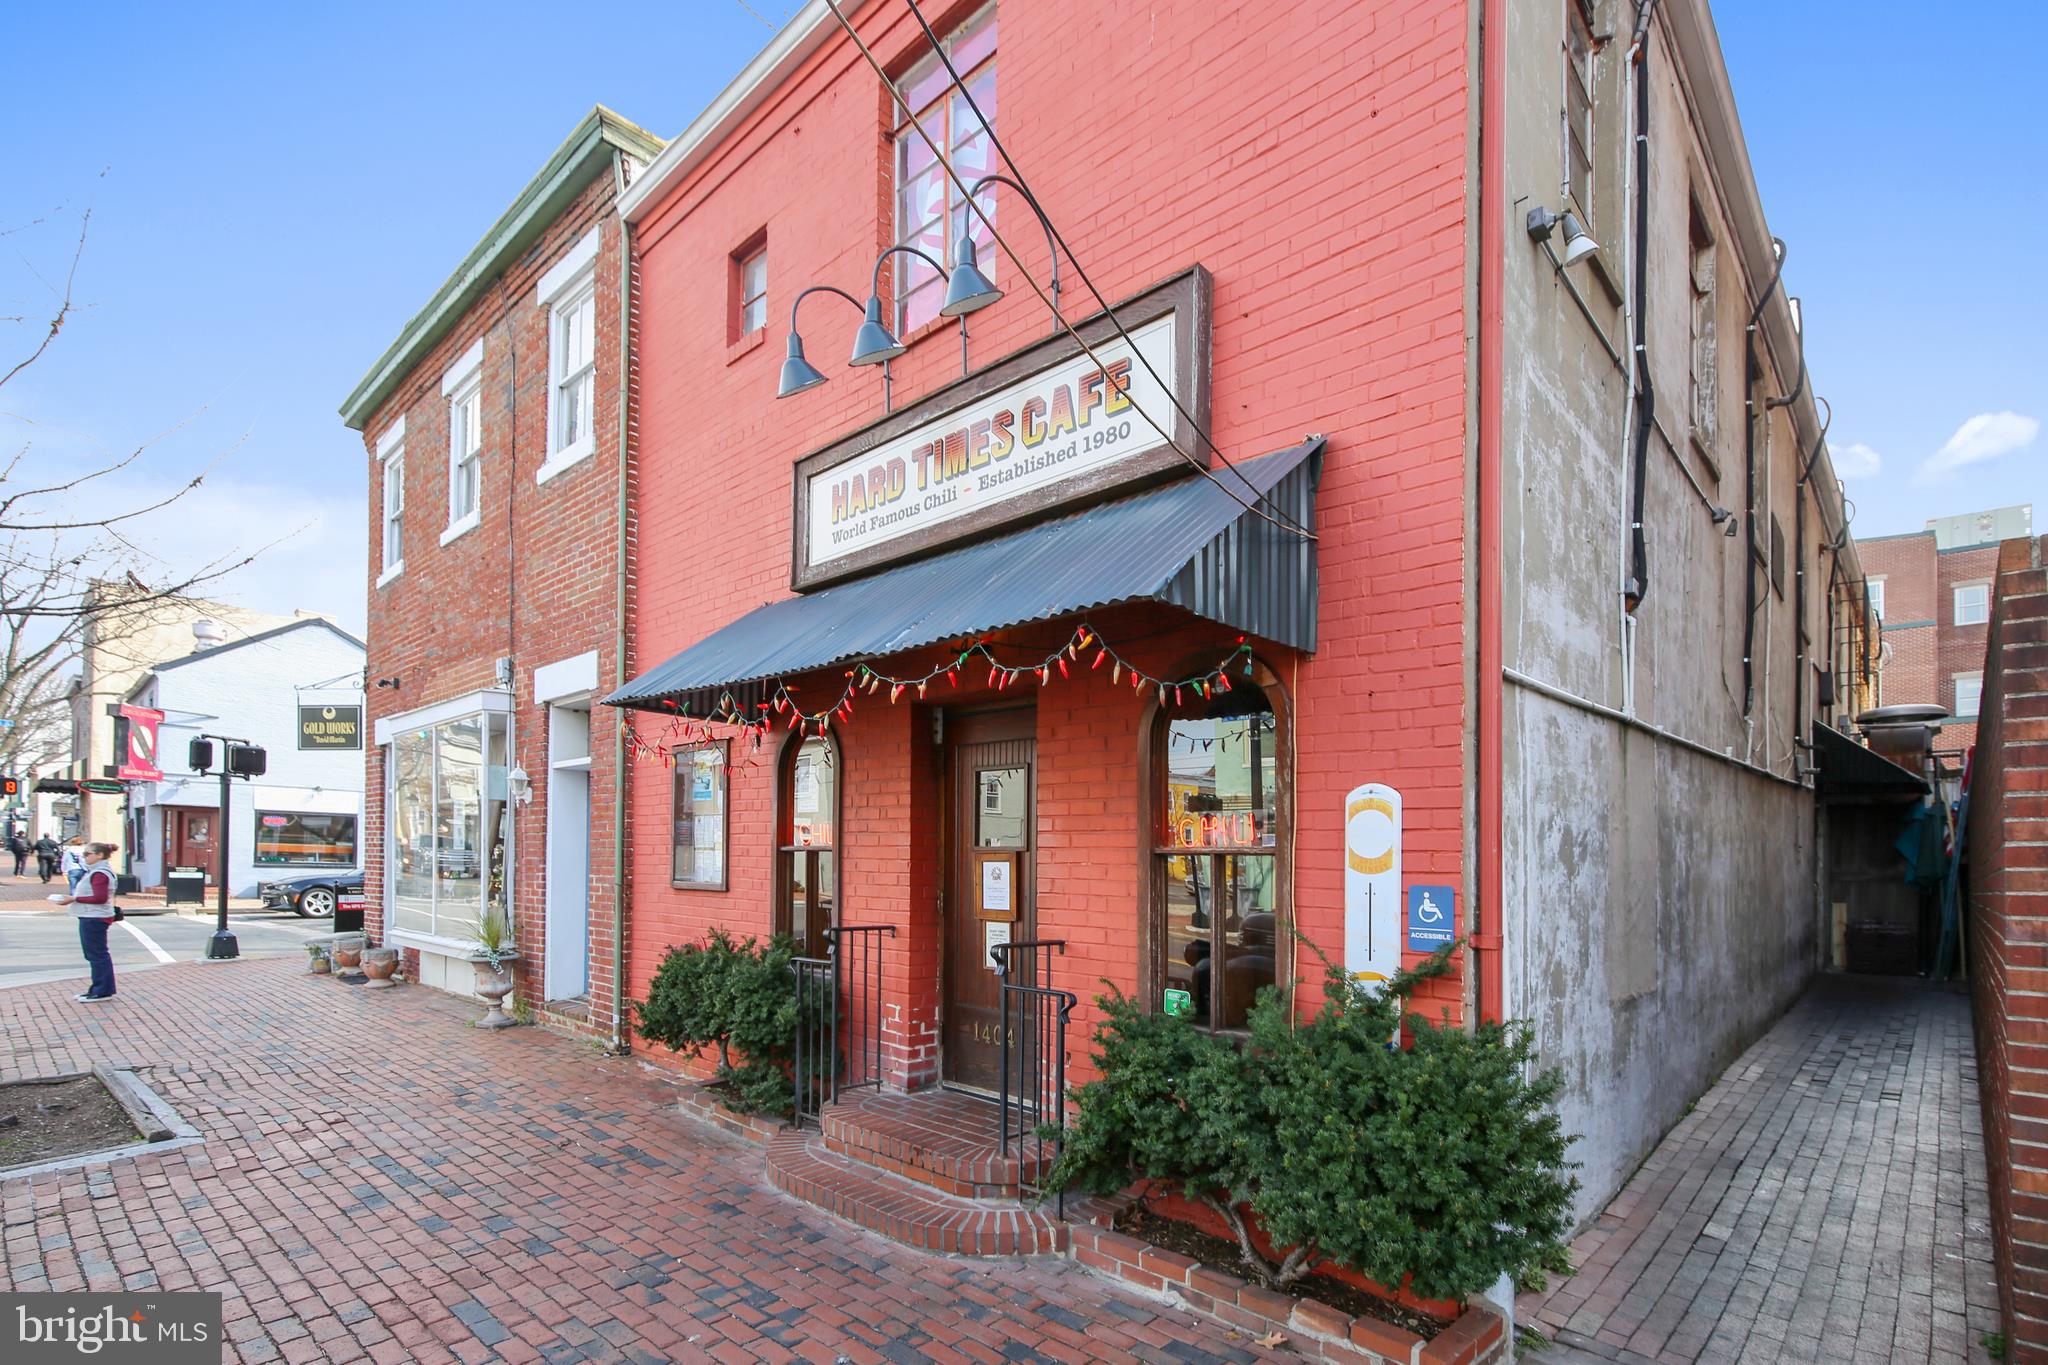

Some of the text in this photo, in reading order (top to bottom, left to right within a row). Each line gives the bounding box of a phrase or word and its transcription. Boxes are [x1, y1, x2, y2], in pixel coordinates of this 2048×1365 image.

[832, 356, 1133, 524] HARD TIMES CAFE
[832, 519, 867, 545] World
[869, 499, 921, 532] Famous
[924, 485, 958, 512] Chili
[978, 441, 1078, 492] Established
[1083, 421, 1132, 454] 1980
[304, 722, 356, 734] GOLD WORKS
[800, 823, 832, 846] CHIL
[1179, 812, 1255, 848] CHILI
[1410, 932, 1451, 941] ACCESSIBLE
